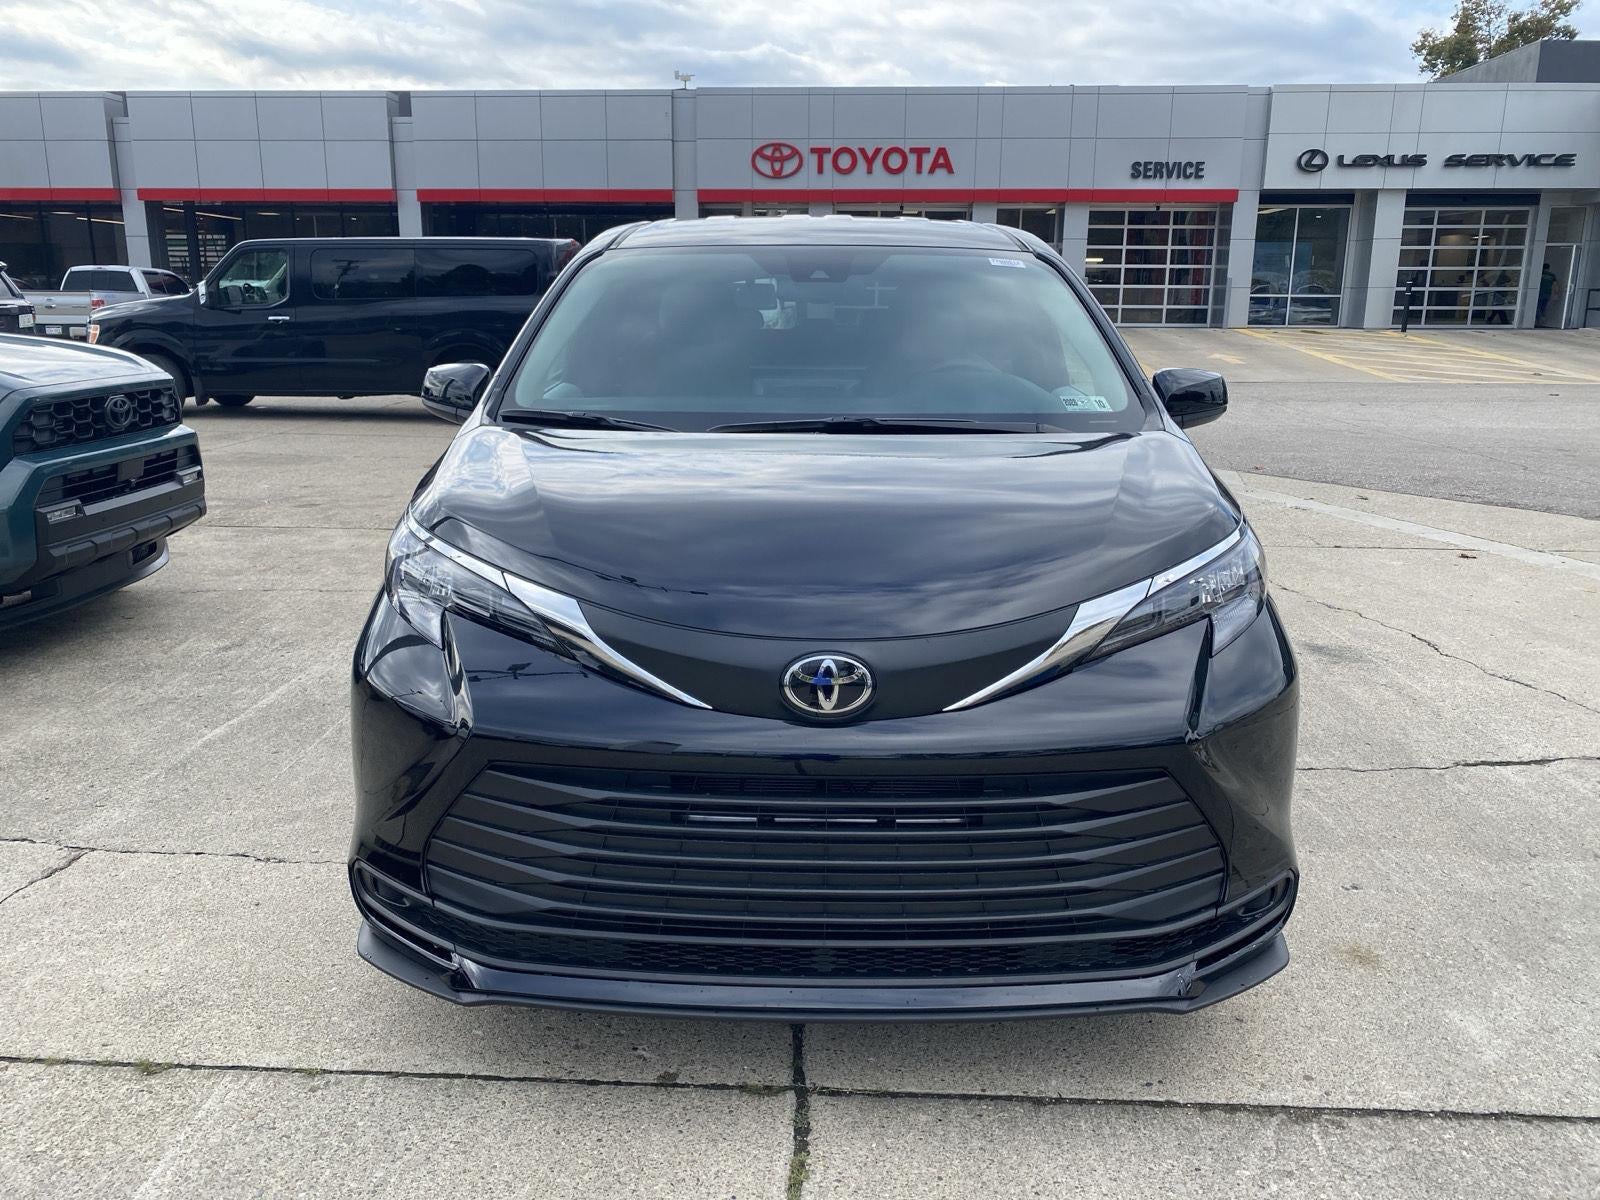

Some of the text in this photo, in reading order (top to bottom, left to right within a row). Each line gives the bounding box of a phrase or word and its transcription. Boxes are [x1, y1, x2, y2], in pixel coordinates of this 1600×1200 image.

[810, 147, 955, 175] TOYOTA
[1336, 153, 1577, 168] LEXUS SERVICE
[1130, 161, 1206, 180] SERVICE
